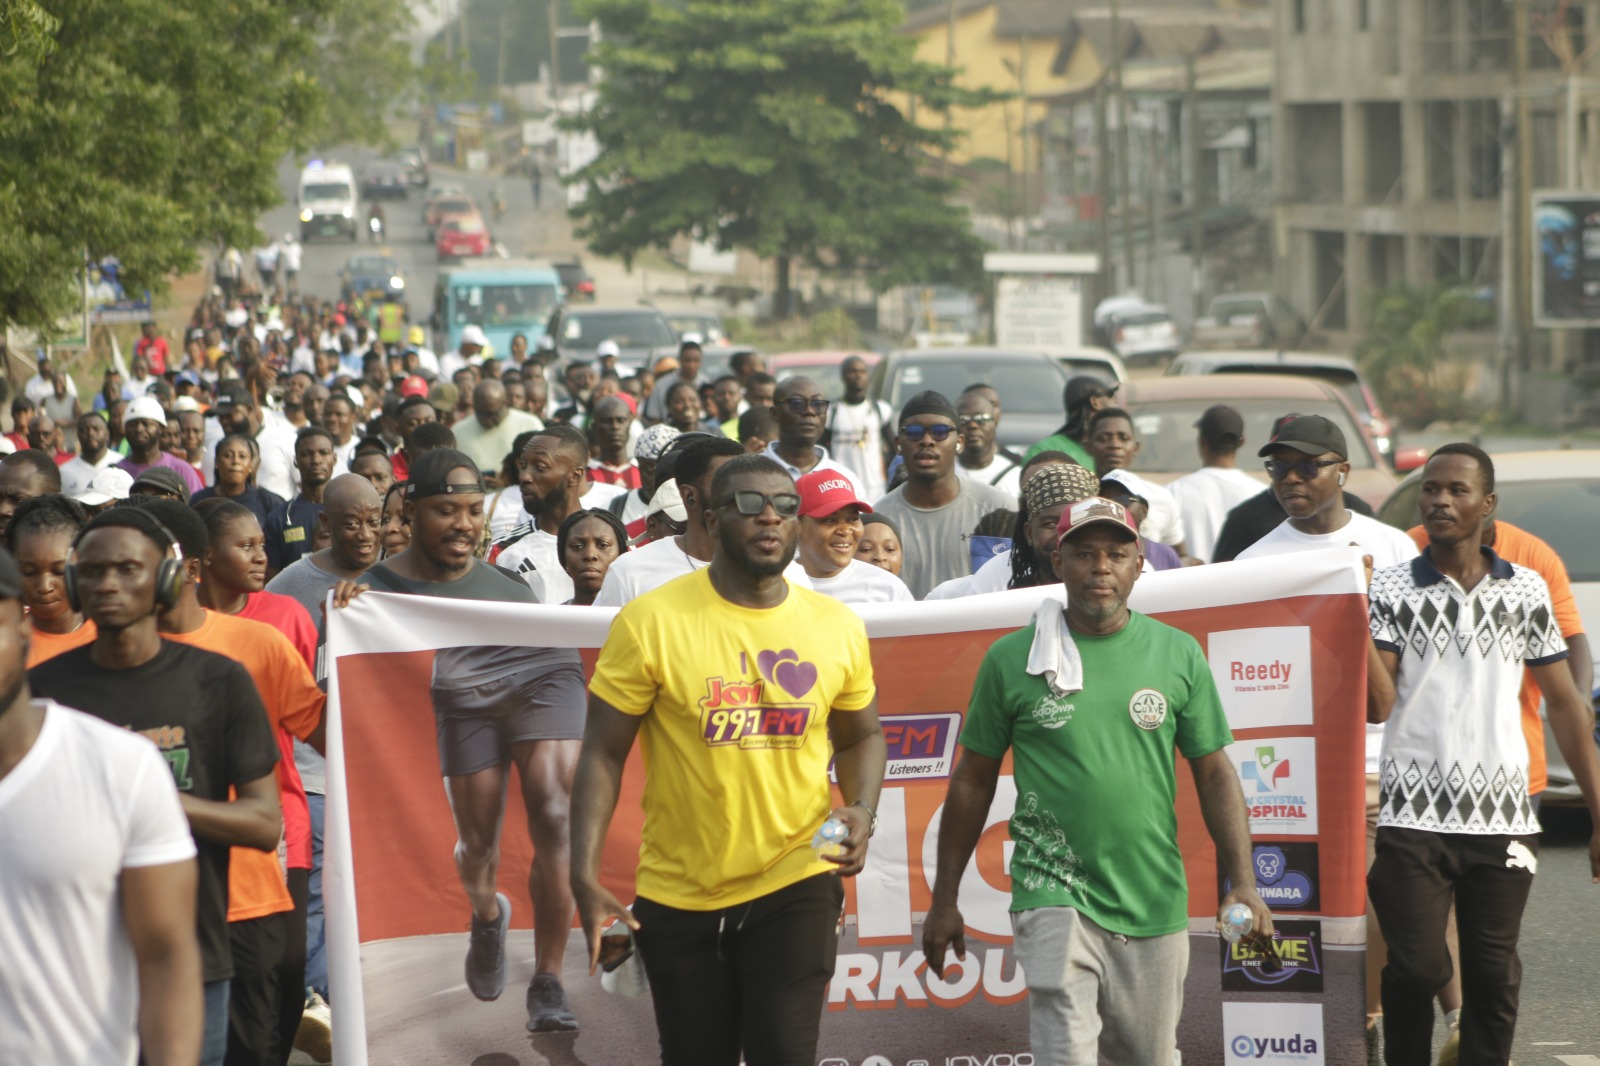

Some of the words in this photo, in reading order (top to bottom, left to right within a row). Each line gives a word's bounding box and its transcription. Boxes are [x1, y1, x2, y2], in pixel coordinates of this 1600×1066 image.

[740, 651, 747, 675] I
[1230, 660, 1291, 682] Reedy
[882, 724, 938, 756] FM
[889, 763, 932, 775] Listeners
[1247, 805, 1307, 818] SPITAL
[1257, 796, 1306, 805] CRYSTAL
[1231, 939, 1308, 962] GME
[827, 948, 1028, 1006] RKOU
